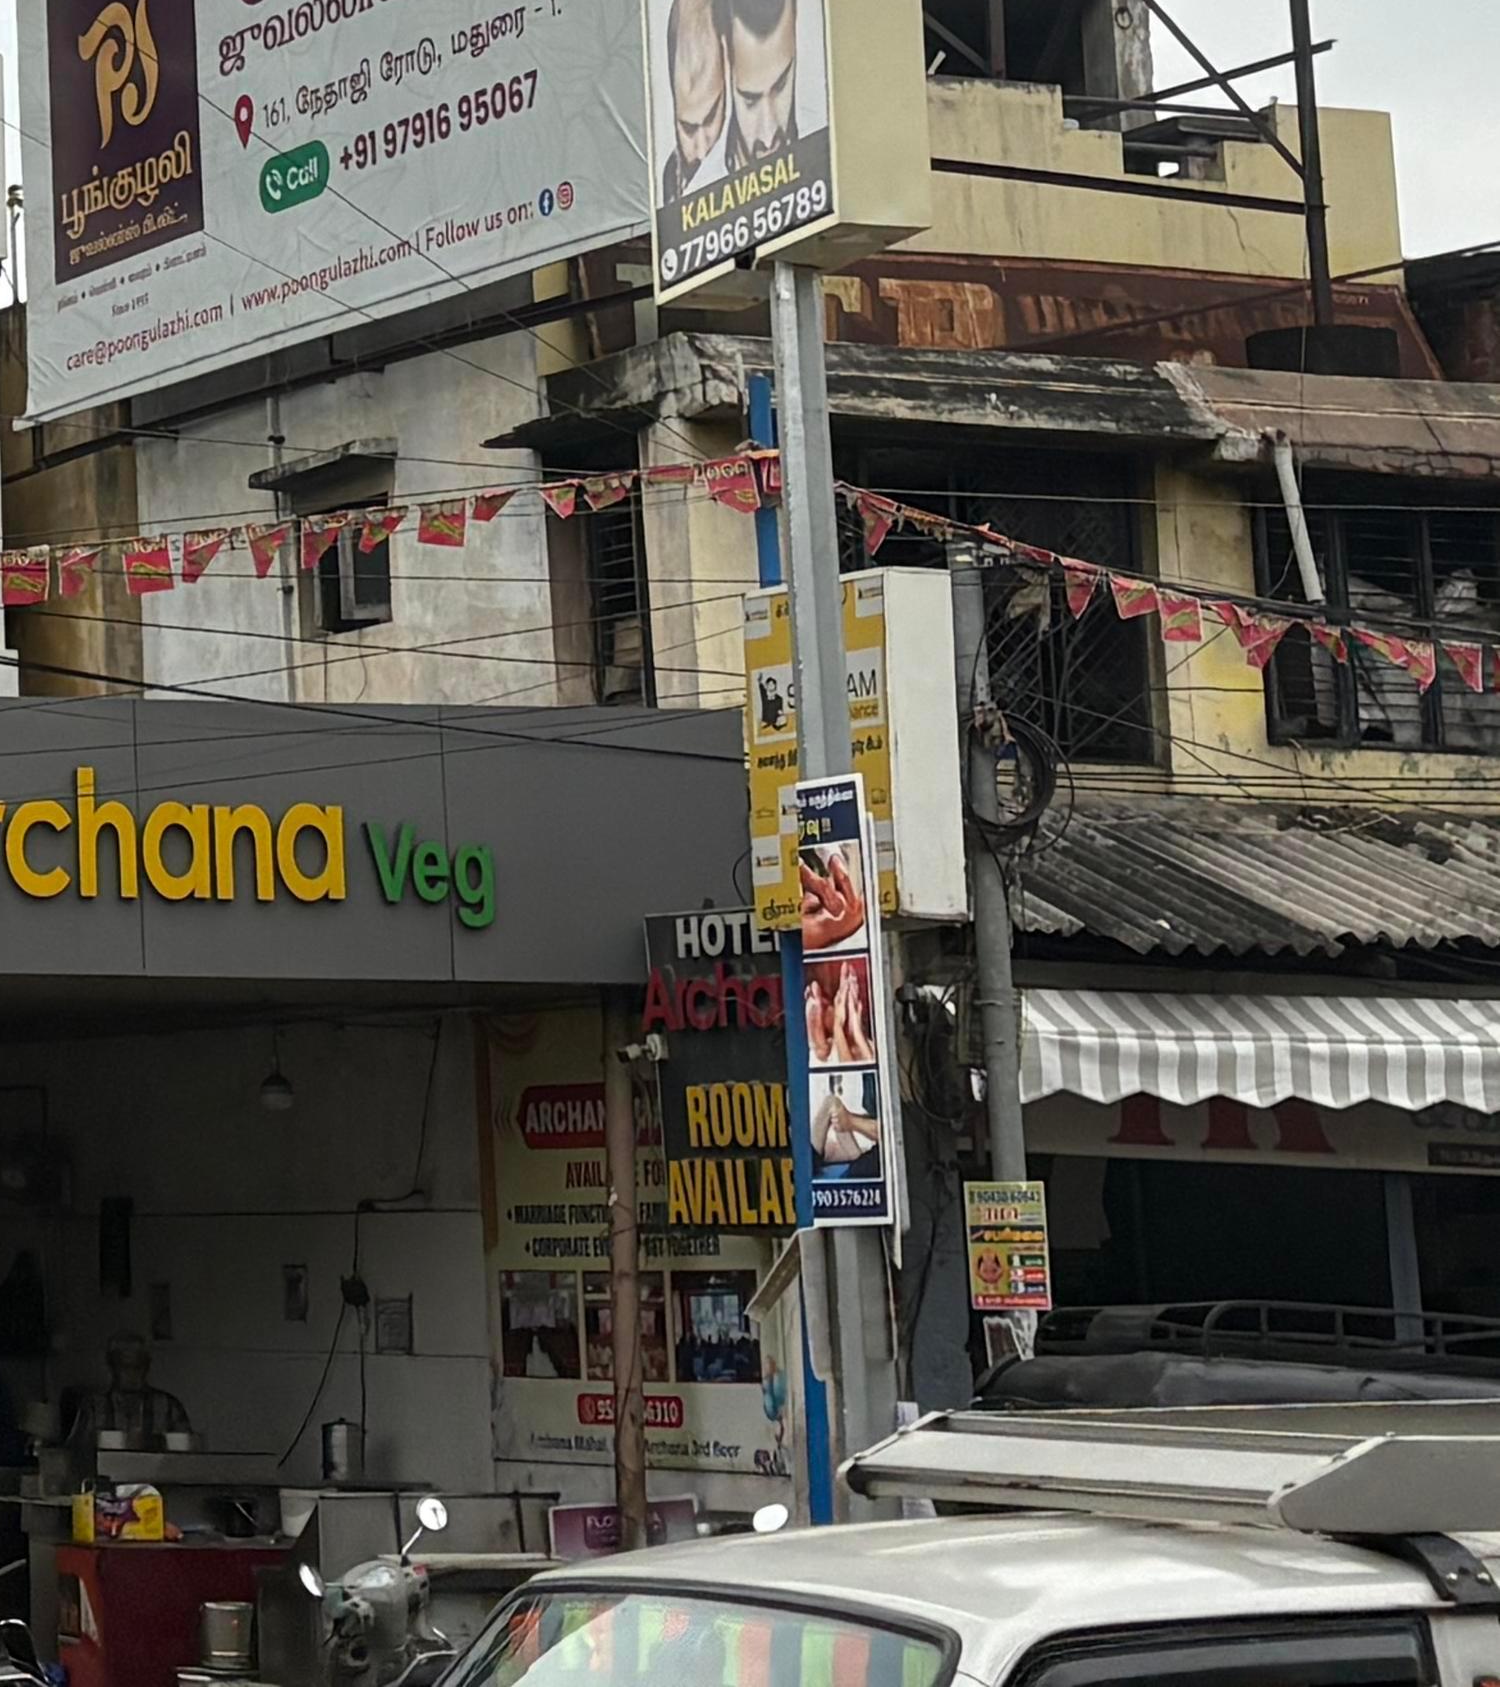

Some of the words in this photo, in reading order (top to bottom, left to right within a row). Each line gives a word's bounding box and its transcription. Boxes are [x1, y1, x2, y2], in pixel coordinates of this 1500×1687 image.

[295, 58, 372, 120] நேதாஜி
[450, 6, 526, 59] மதுரை
[339, 130, 377, 171] +91
[383, 102, 451, 159] 97916
[457, 69, 539, 132] 95067
[61, 129, 194, 240] பூங்குழலி
[286, 157, 319, 192] Call
[681, 153, 801, 233] KALAVASAL
[679, 216, 749, 273] 77966
[752, 179, 828, 240] 56789
[66, 302, 224, 372] care@poongulazhi.com
[240, 238, 412, 312] www.poongulazhi.com
[424, 217, 481, 252] Follow
[484, 211, 504, 231] us
[362, 819, 496, 929] Veg
[675, 912, 783, 960] HOTE
[640, 962, 784, 1032] Archa
[685, 1081, 790, 1149] ROOM
